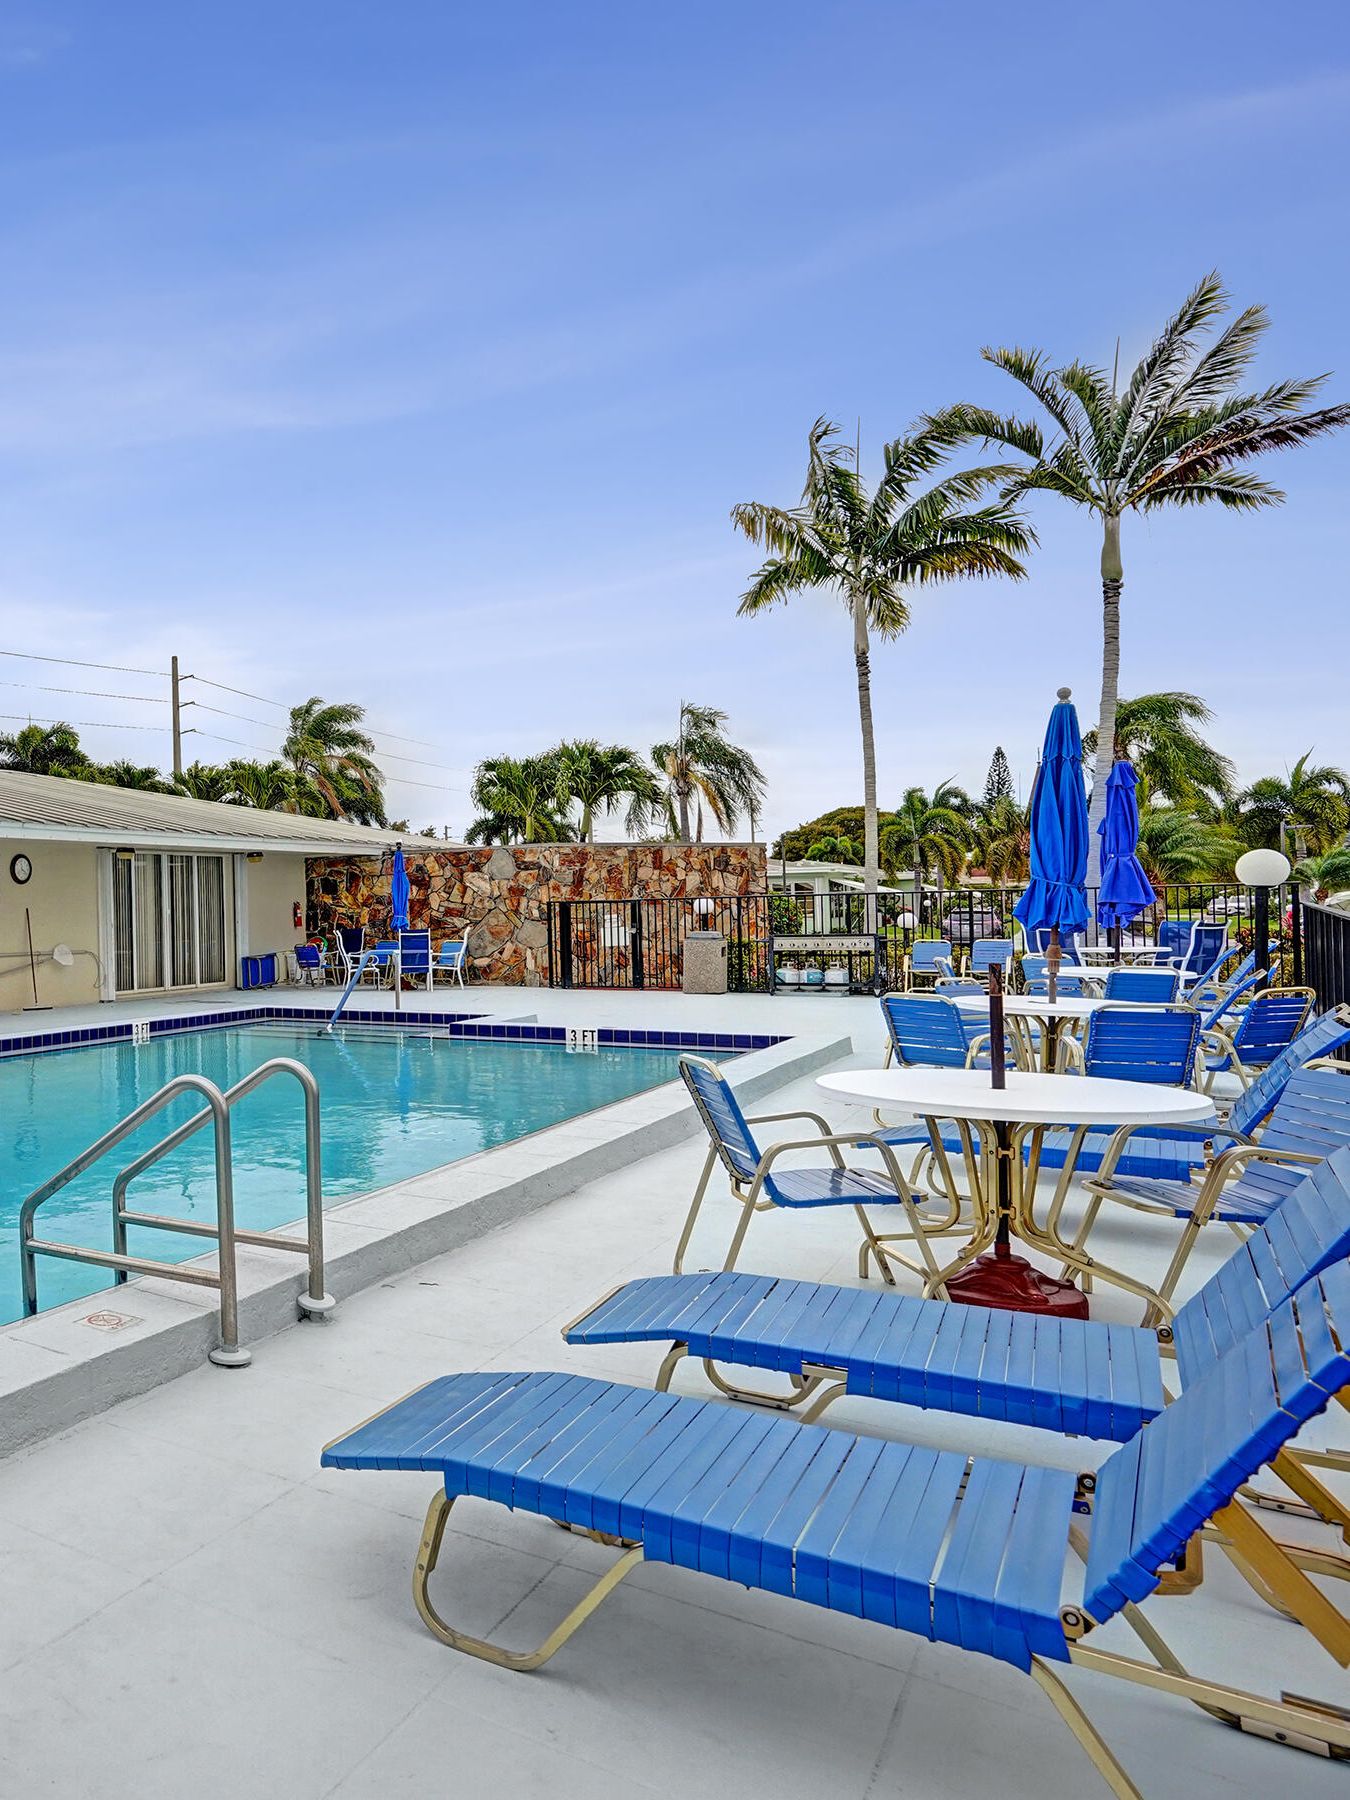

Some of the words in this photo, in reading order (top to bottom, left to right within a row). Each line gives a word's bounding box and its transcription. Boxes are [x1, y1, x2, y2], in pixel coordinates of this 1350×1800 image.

[135, 1024, 139, 1035] 3
[570, 1030, 577, 1042] 3
[582, 1030, 596, 1042] FT
